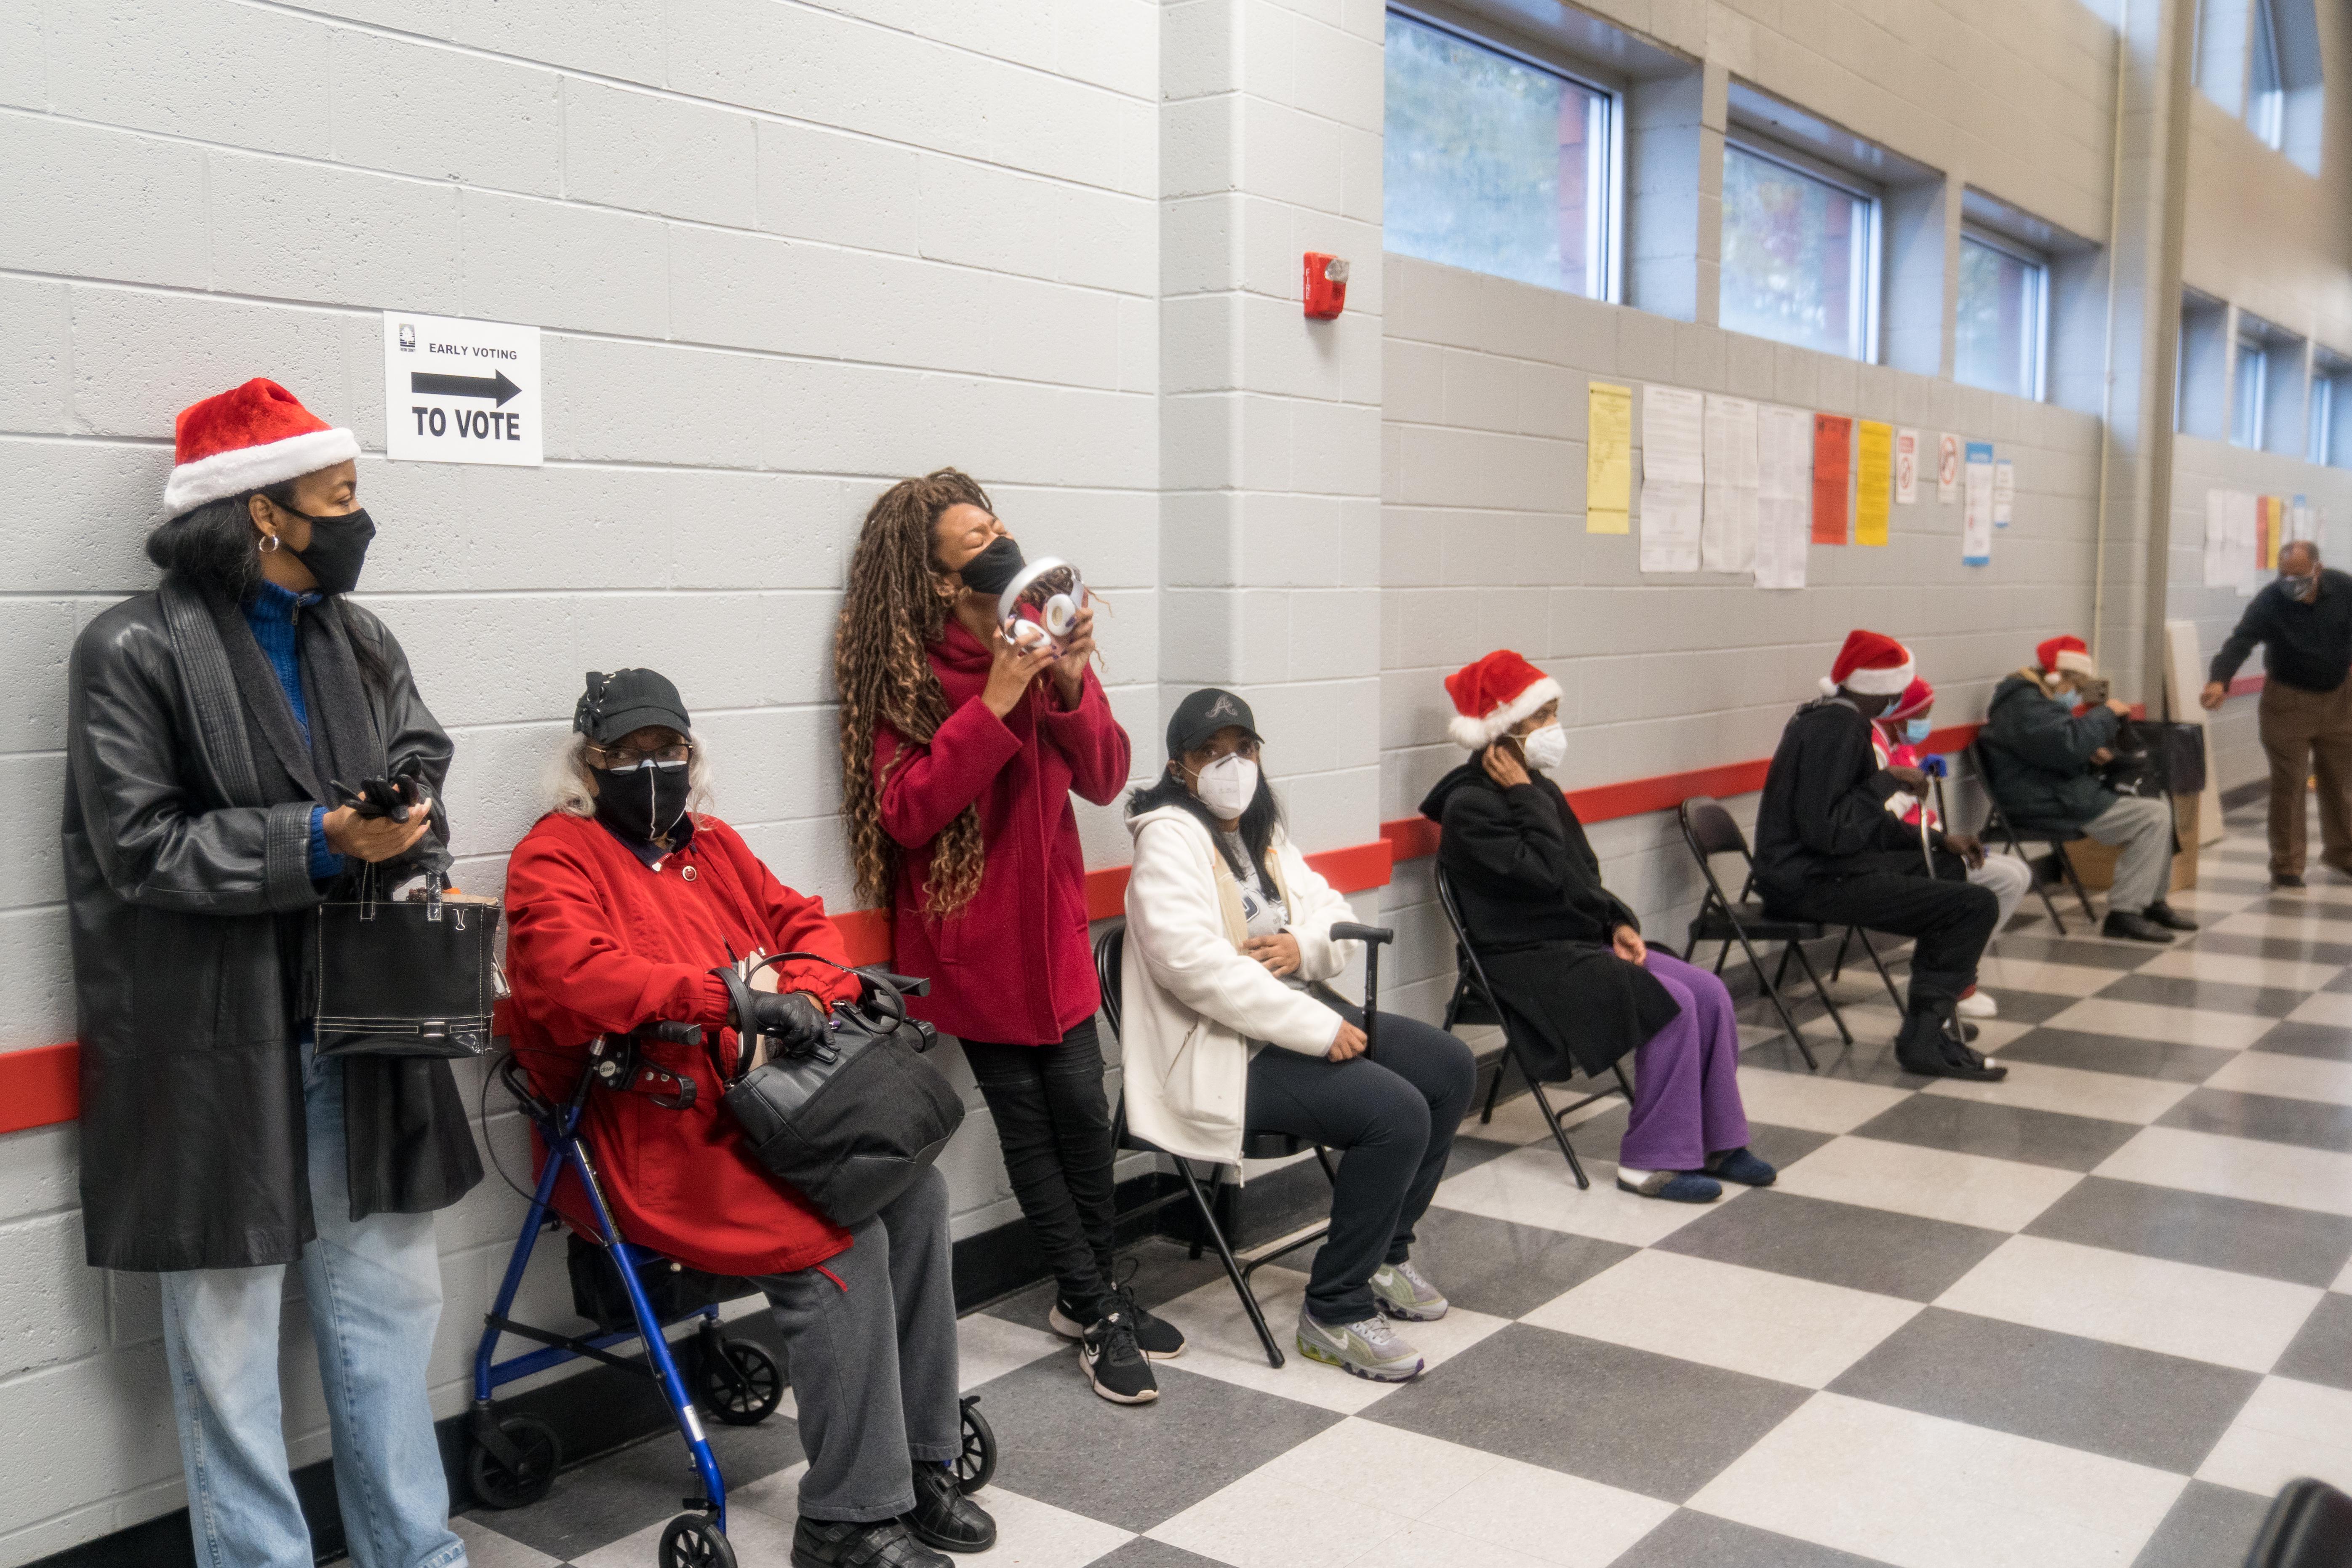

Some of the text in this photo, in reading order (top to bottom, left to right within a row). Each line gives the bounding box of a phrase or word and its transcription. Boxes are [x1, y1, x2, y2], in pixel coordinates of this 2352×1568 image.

[429, 343, 517, 360] EARLY VOTING
[412, 406, 520, 441] TO VOTE
[1205, 694, 1238, 718] A
